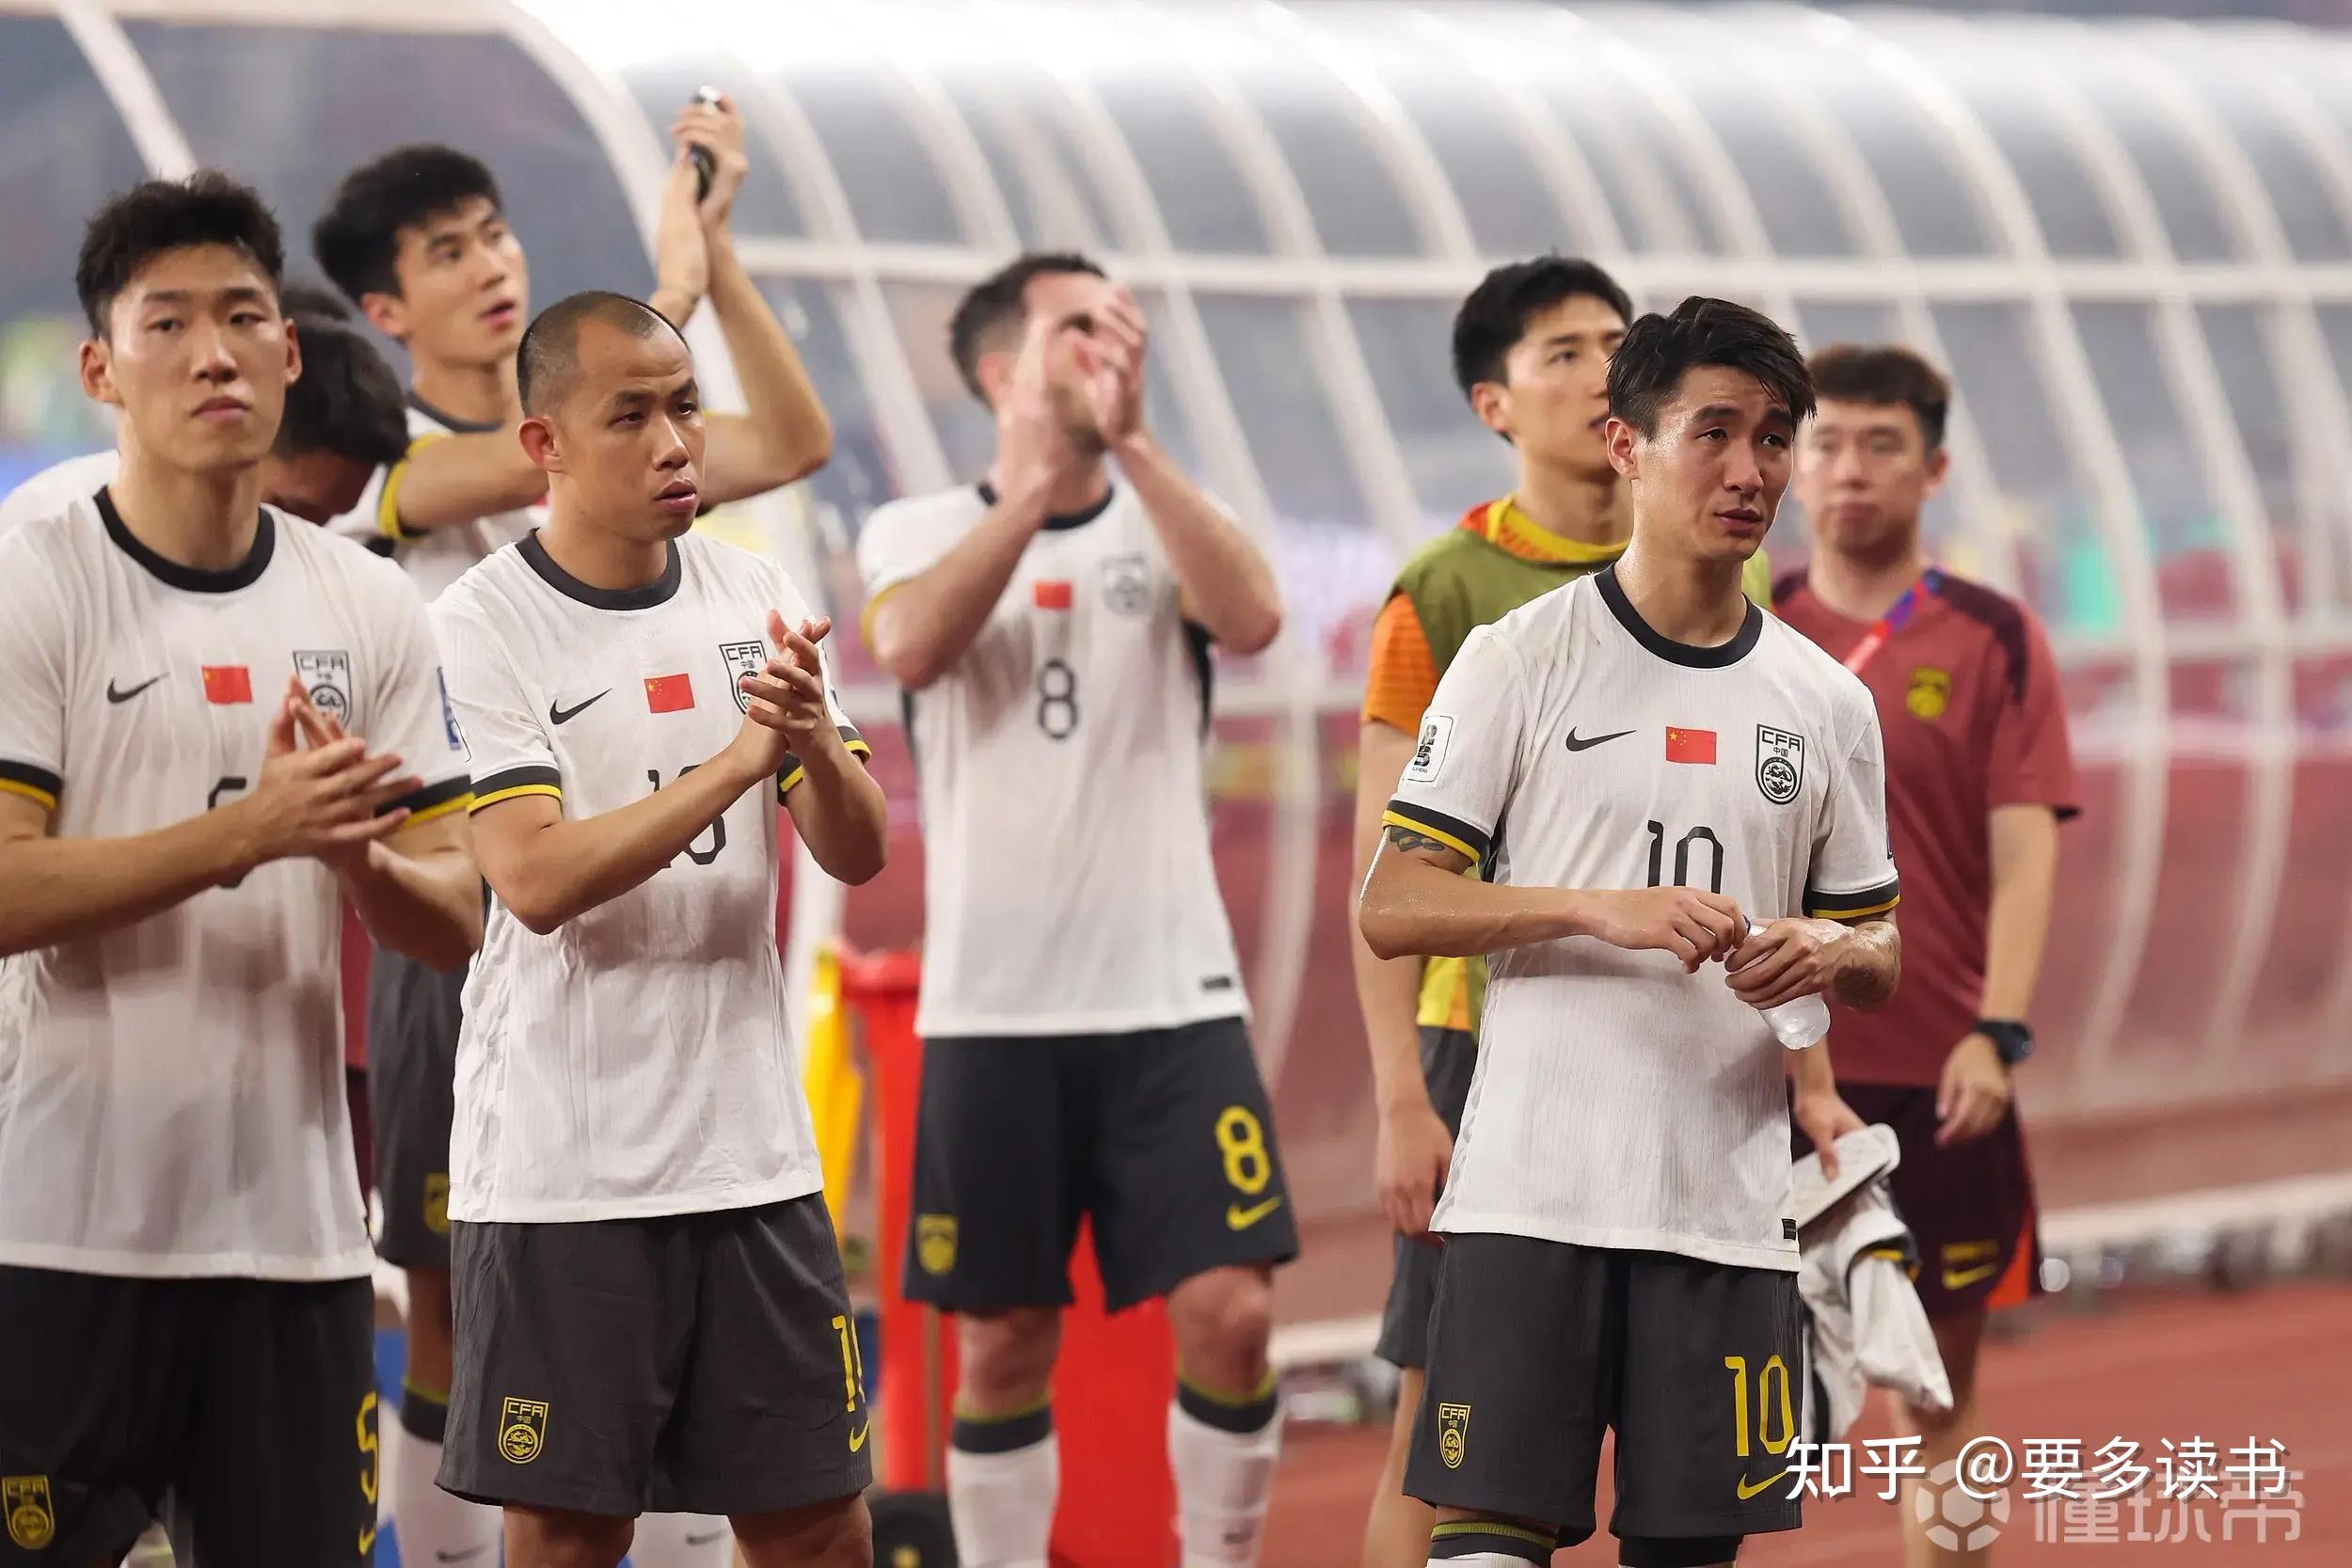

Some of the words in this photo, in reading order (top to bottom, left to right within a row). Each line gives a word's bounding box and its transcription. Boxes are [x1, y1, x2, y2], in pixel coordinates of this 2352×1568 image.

[725, 645, 762, 660] CFA
[1036, 658, 1078, 739] 8
[1761, 729, 1801, 752] CFA
[1772, 746, 1788, 758] 中国
[1647, 819, 1724, 895] 10
[1216, 1106, 1271, 1195] 8
[508, 1402, 544, 1418] CFA
[1441, 1407, 1467, 1421] CFA
[1724, 1354, 1794, 1457] 10
